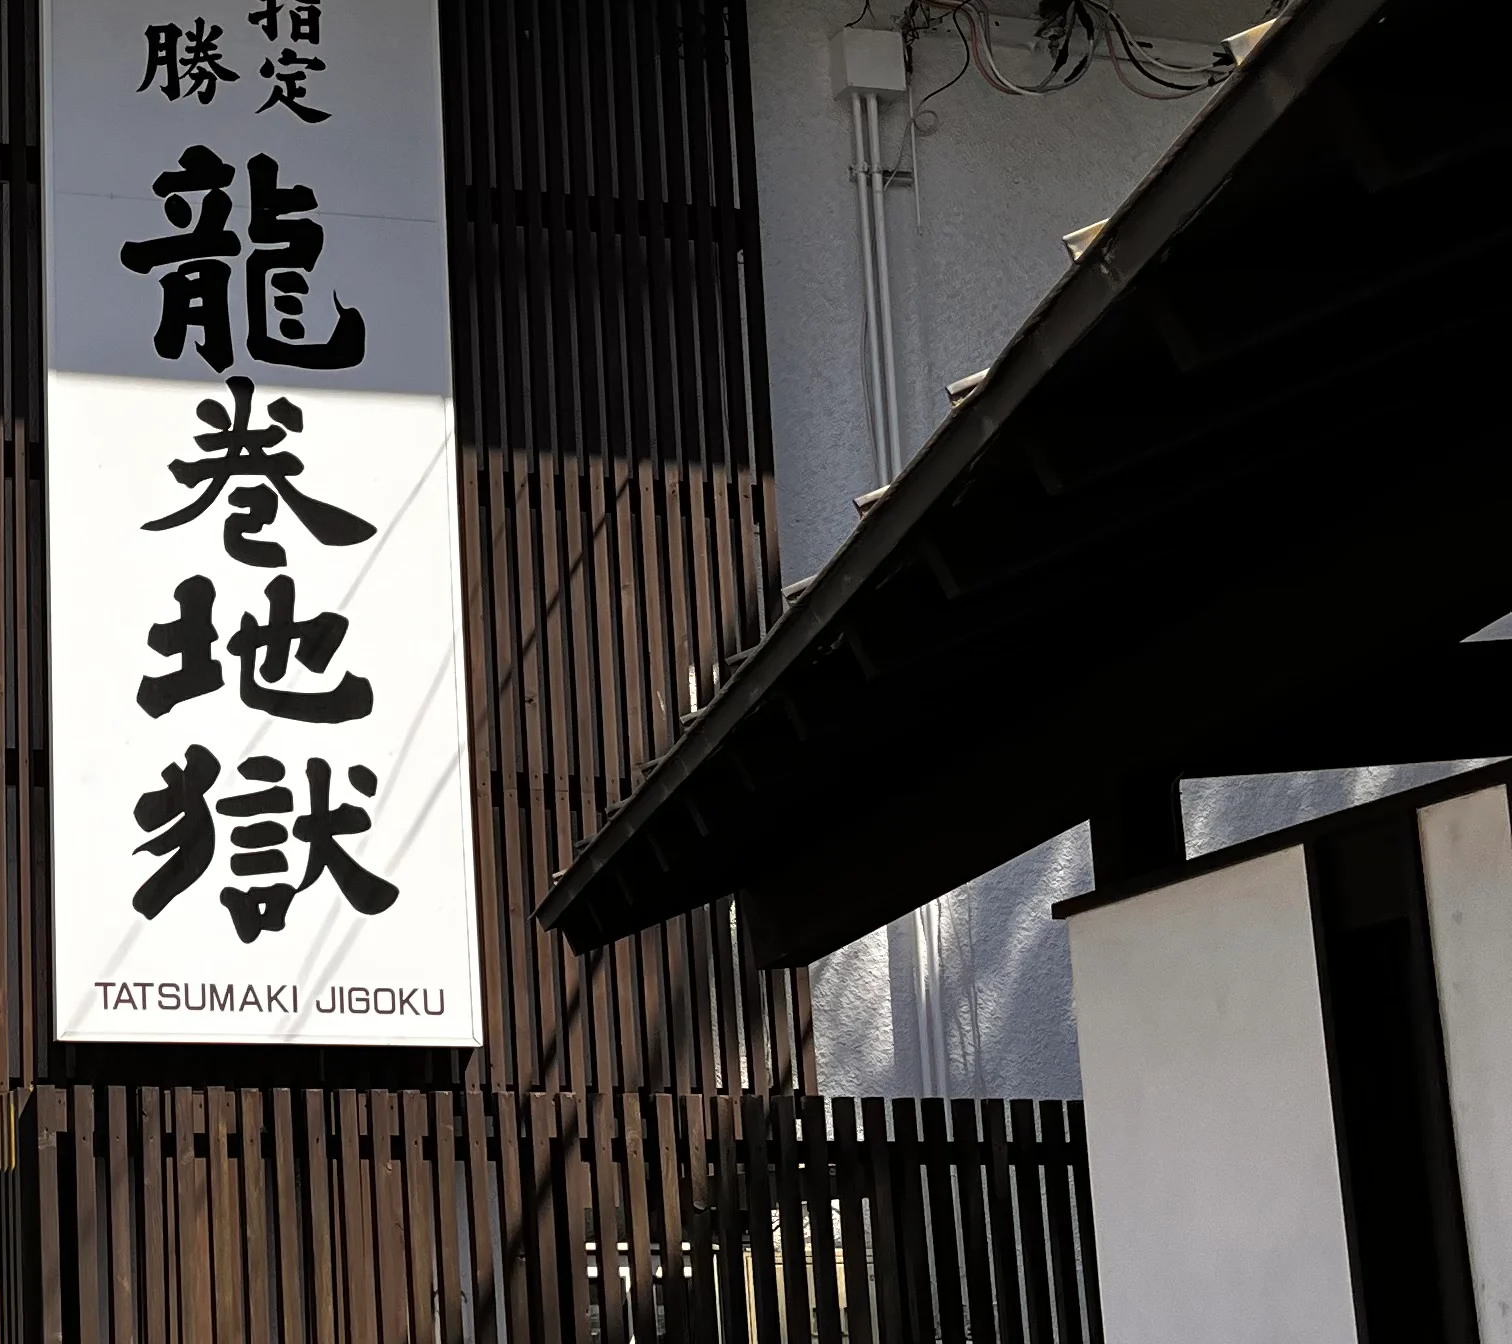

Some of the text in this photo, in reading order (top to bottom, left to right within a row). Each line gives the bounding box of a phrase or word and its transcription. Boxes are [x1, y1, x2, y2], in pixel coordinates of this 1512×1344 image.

[120, 144, 400, 944] 龍巻地獄
[94, 981, 446, 1016] TATSUMAKI JIGOKU
